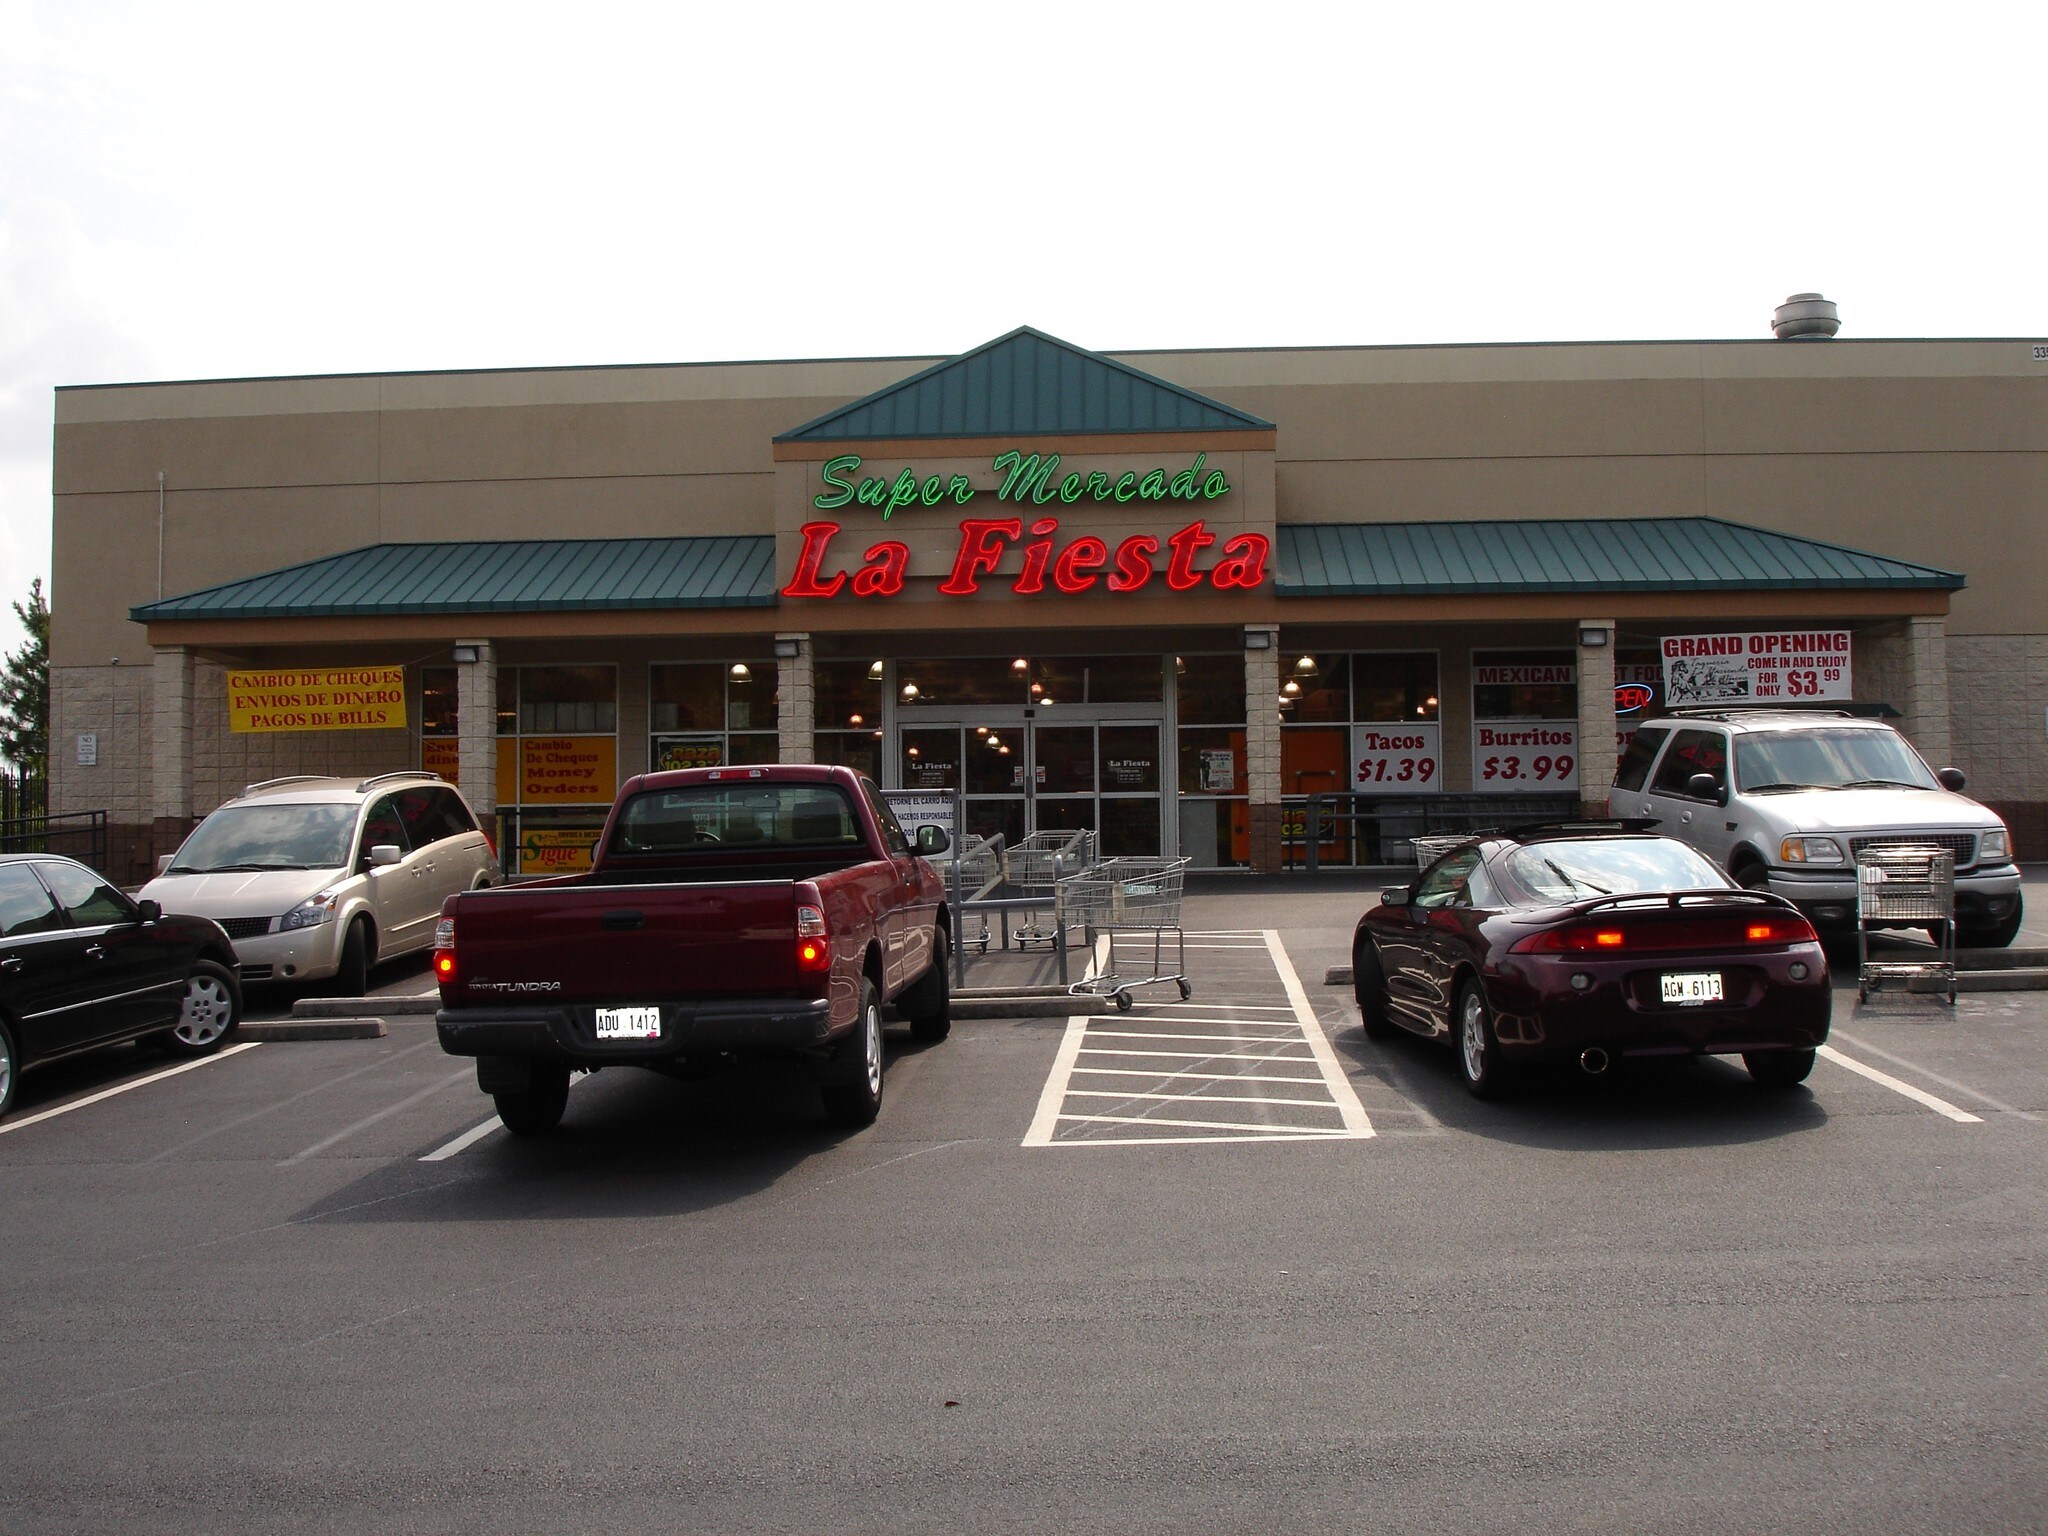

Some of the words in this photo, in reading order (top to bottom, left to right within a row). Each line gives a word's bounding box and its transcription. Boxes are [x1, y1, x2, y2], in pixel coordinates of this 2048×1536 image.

[814, 453, 975, 521] Super
[993, 450, 1231, 508] Mercado
[781, 520, 910, 597] La
[937, 517, 1271, 596] Fiesta
[1663, 637, 1743, 657] GRAND
[1749, 633, 1848, 654] OPENING
[1748, 657, 1777, 669] COME
[1780, 657, 1791, 668] IN
[1792, 656, 1813, 668] AND
[1817, 656, 1847, 667] ENJOY
[231, 675, 296, 688] CAMBIO
[301, 674, 322, 686] DE
[326, 671, 402, 686] CHEQUES
[1479, 668, 1570, 683] MEXICAN
[1635, 666, 1664, 682] FOO
[1758, 672, 1778, 683] FOR
[1615, 689, 1649, 707] PEN
[1756, 685, 1780, 696] ONLY
[235, 694, 301, 709] ENVIOS
[305, 693, 329, 706] DE
[333, 690, 402, 705] DINERO
[251, 713, 306, 727] PAGOS
[311, 712, 334, 725] DE
[338, 710, 387, 724] BILLS
[525, 740, 572, 750] Cambio
[1366, 733, 1425, 750] Tacos
[1480, 728, 1572, 747] Burritos
[527, 753, 544, 763] De
[546, 753, 598, 765] Cheques
[925, 762, 952, 770] Fiesta
[1123, 759, 1150, 767] Fiesta
[527, 768, 596, 778] Money
[1357, 758, 1435, 783] $1.39
[1483, 755, 1574, 781] $3.99
[526, 783, 599, 794] Orders
[913, 797, 920, 805] EL
[921, 796, 939, 805] CARRO
[941, 796, 953, 804] AQU
[898, 812, 919, 820] HACEMOS
[523, 833, 578, 866] Sigue
[496, 981, 561, 991] TUNDRA
[1693, 980, 1721, 996] 6113
[598, 1015, 619, 1031] ADU
[630, 1014, 657, 1031] 1412
